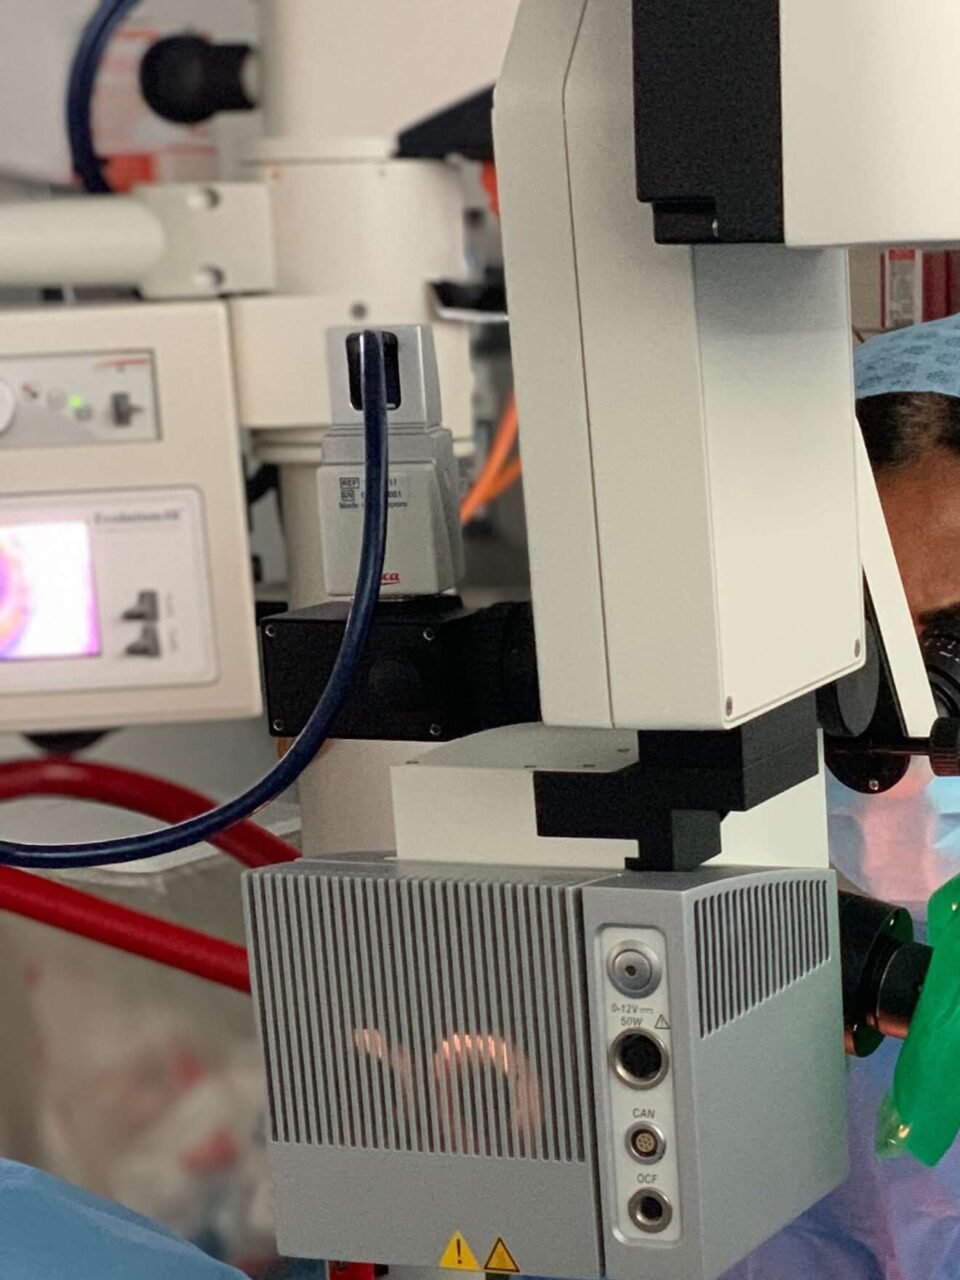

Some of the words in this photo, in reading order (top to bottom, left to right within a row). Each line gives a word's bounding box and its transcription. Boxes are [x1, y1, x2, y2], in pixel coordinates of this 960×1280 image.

[611, 1003, 638, 1014] 0-12V
[620, 1016, 643, 1026] 50W
[632, 1108, 655, 1118] CAN
[636, 1173, 658, 1184] OCF
